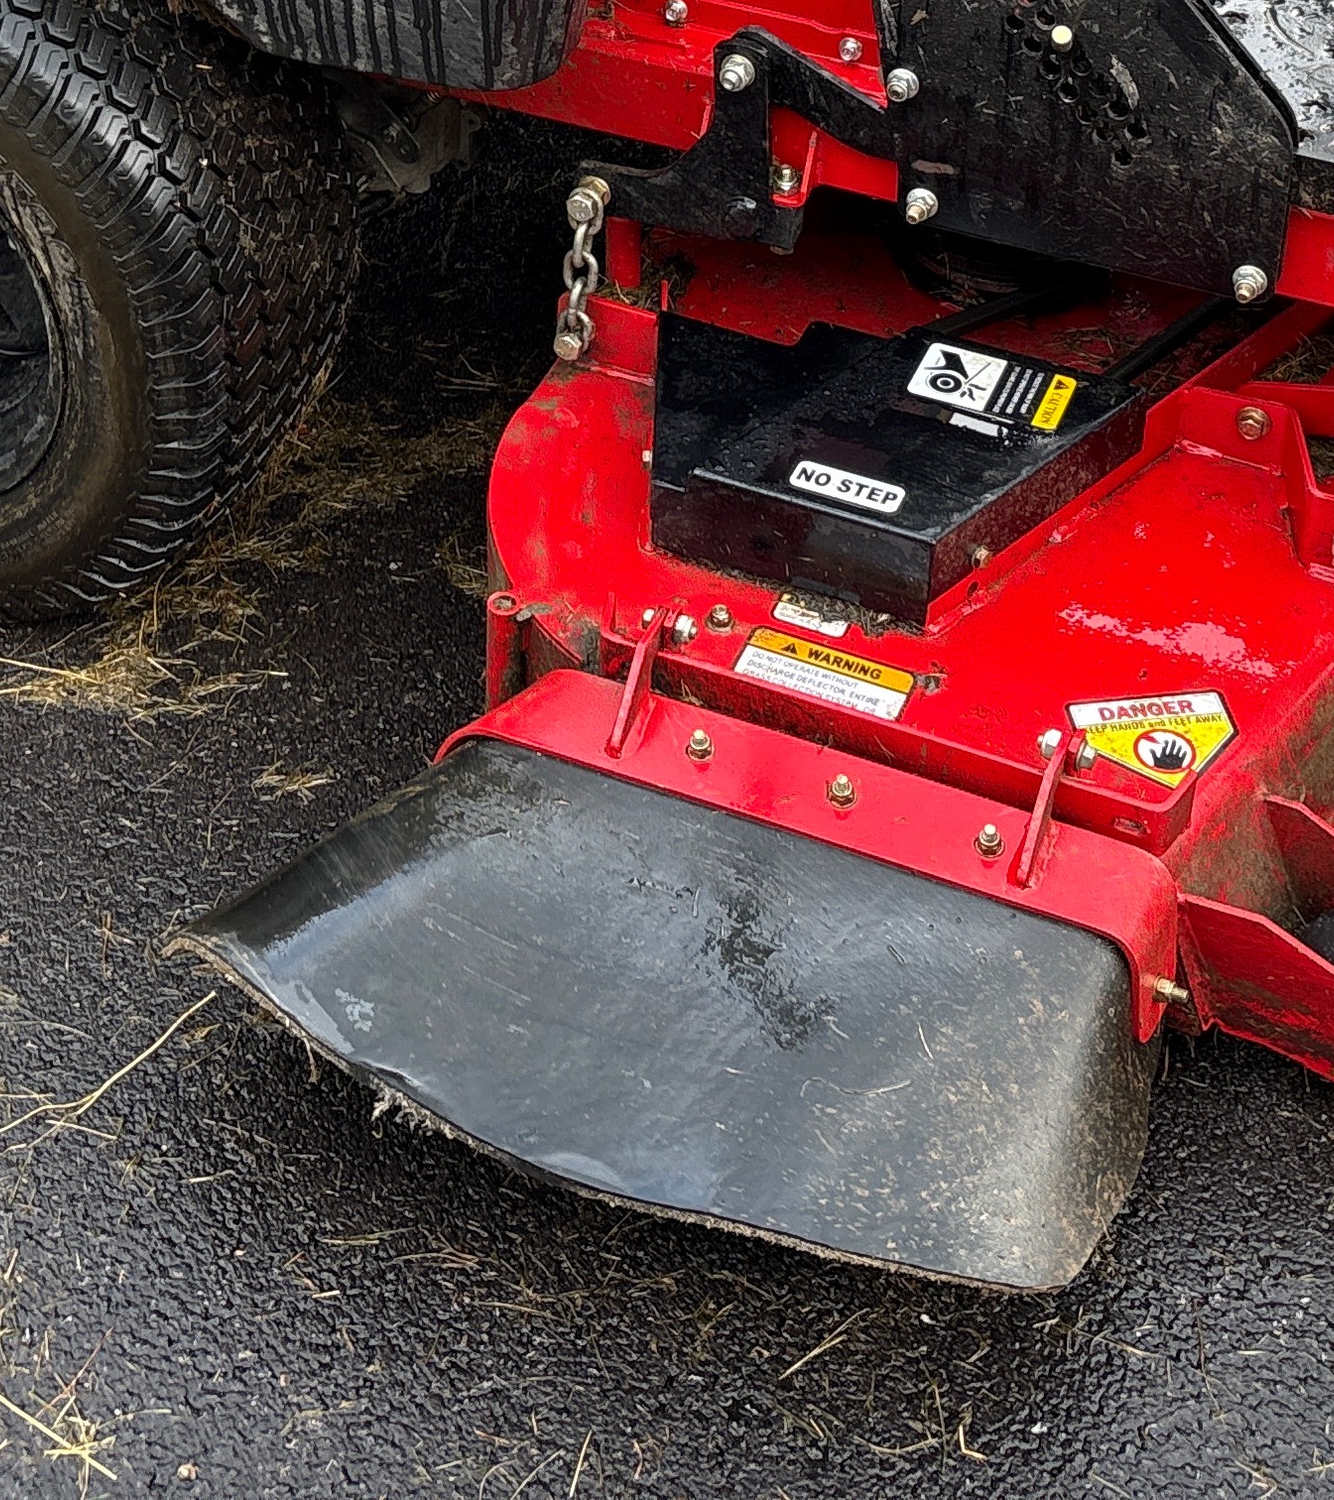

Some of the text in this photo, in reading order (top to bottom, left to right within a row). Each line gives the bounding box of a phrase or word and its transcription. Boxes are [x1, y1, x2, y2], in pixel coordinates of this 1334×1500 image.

[1038, 391, 1063, 426] CAUTION
[796, 466, 898, 505] NO STEP
[752, 651, 858, 688] DO NOT OPERATE WITHOUT
[807, 647, 883, 680] WARNING
[747, 659, 881, 707] DISCHARGE DEFLECTOR ENTIRE
[1097, 699, 1195, 722] DANGER
[1110, 720, 1146, 733] HANDS
[1148, 718, 1166, 729] and
[1169, 716, 1192, 727] FEET
[1195, 713, 1223, 724] AWAY
